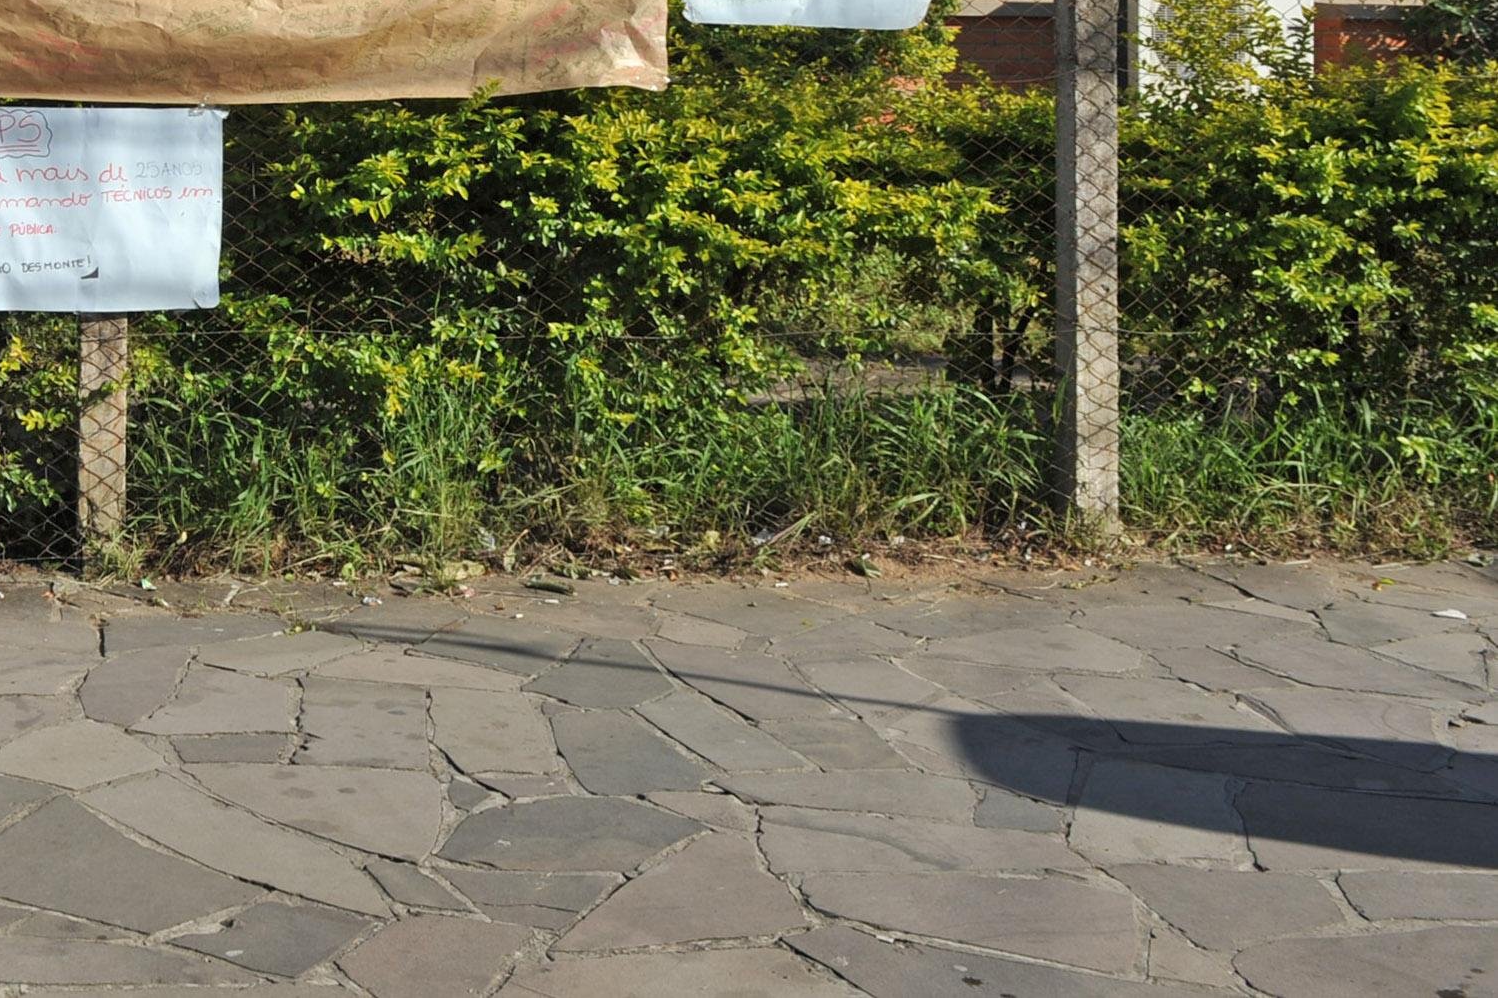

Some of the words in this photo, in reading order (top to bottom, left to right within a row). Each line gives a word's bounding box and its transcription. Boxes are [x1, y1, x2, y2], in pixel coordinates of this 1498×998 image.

[15, 163, 90, 182] mais
[178, 187, 213, 200] em
[22, 255, 91, 273] DESMONTE!
